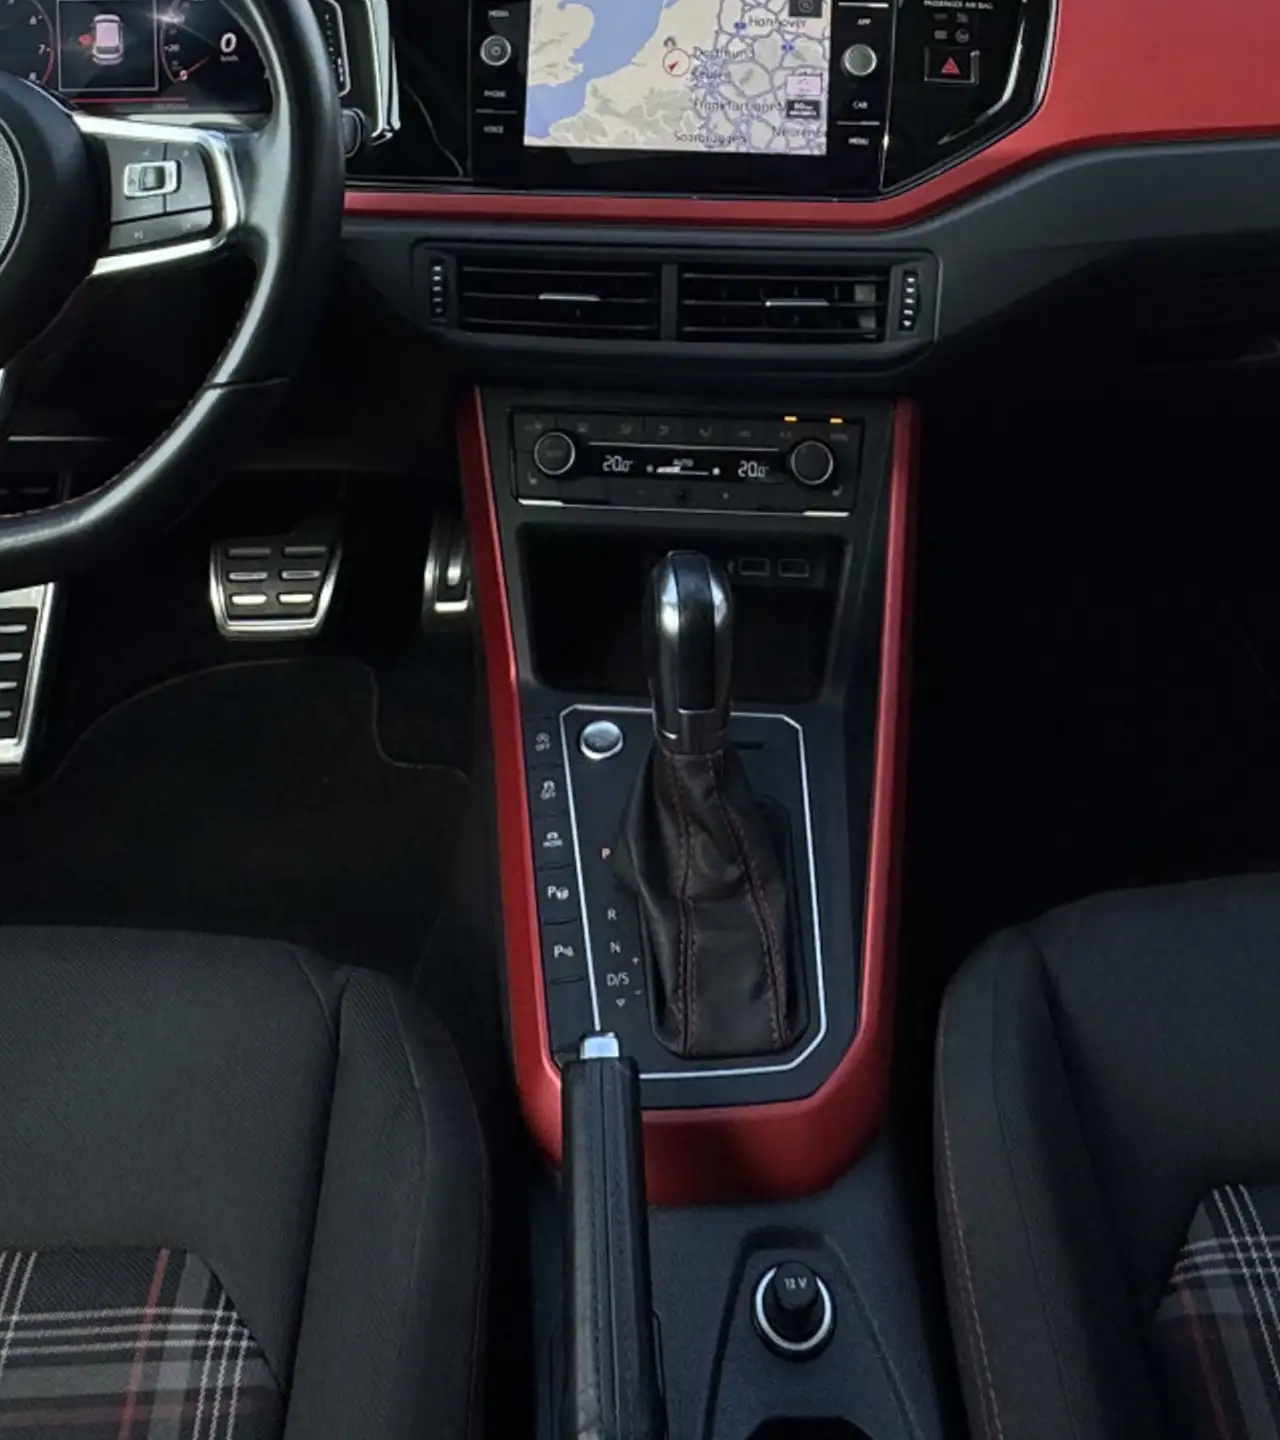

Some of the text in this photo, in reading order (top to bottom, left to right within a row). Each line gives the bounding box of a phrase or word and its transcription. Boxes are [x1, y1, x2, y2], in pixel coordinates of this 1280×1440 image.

[748, 15, 807, 28] Hannover
[856, 18, 872, 26] APP
[220, 32, 237, 53] 0
[694, 100, 750, 113] Frankfurt
[602, 848, 612, 860] P
[607, 909, 617, 921] R
[610, 942, 621, 954] N
[606, 972, 629, 986] D/S
[784, 1276, 808, 1290] 12 V
